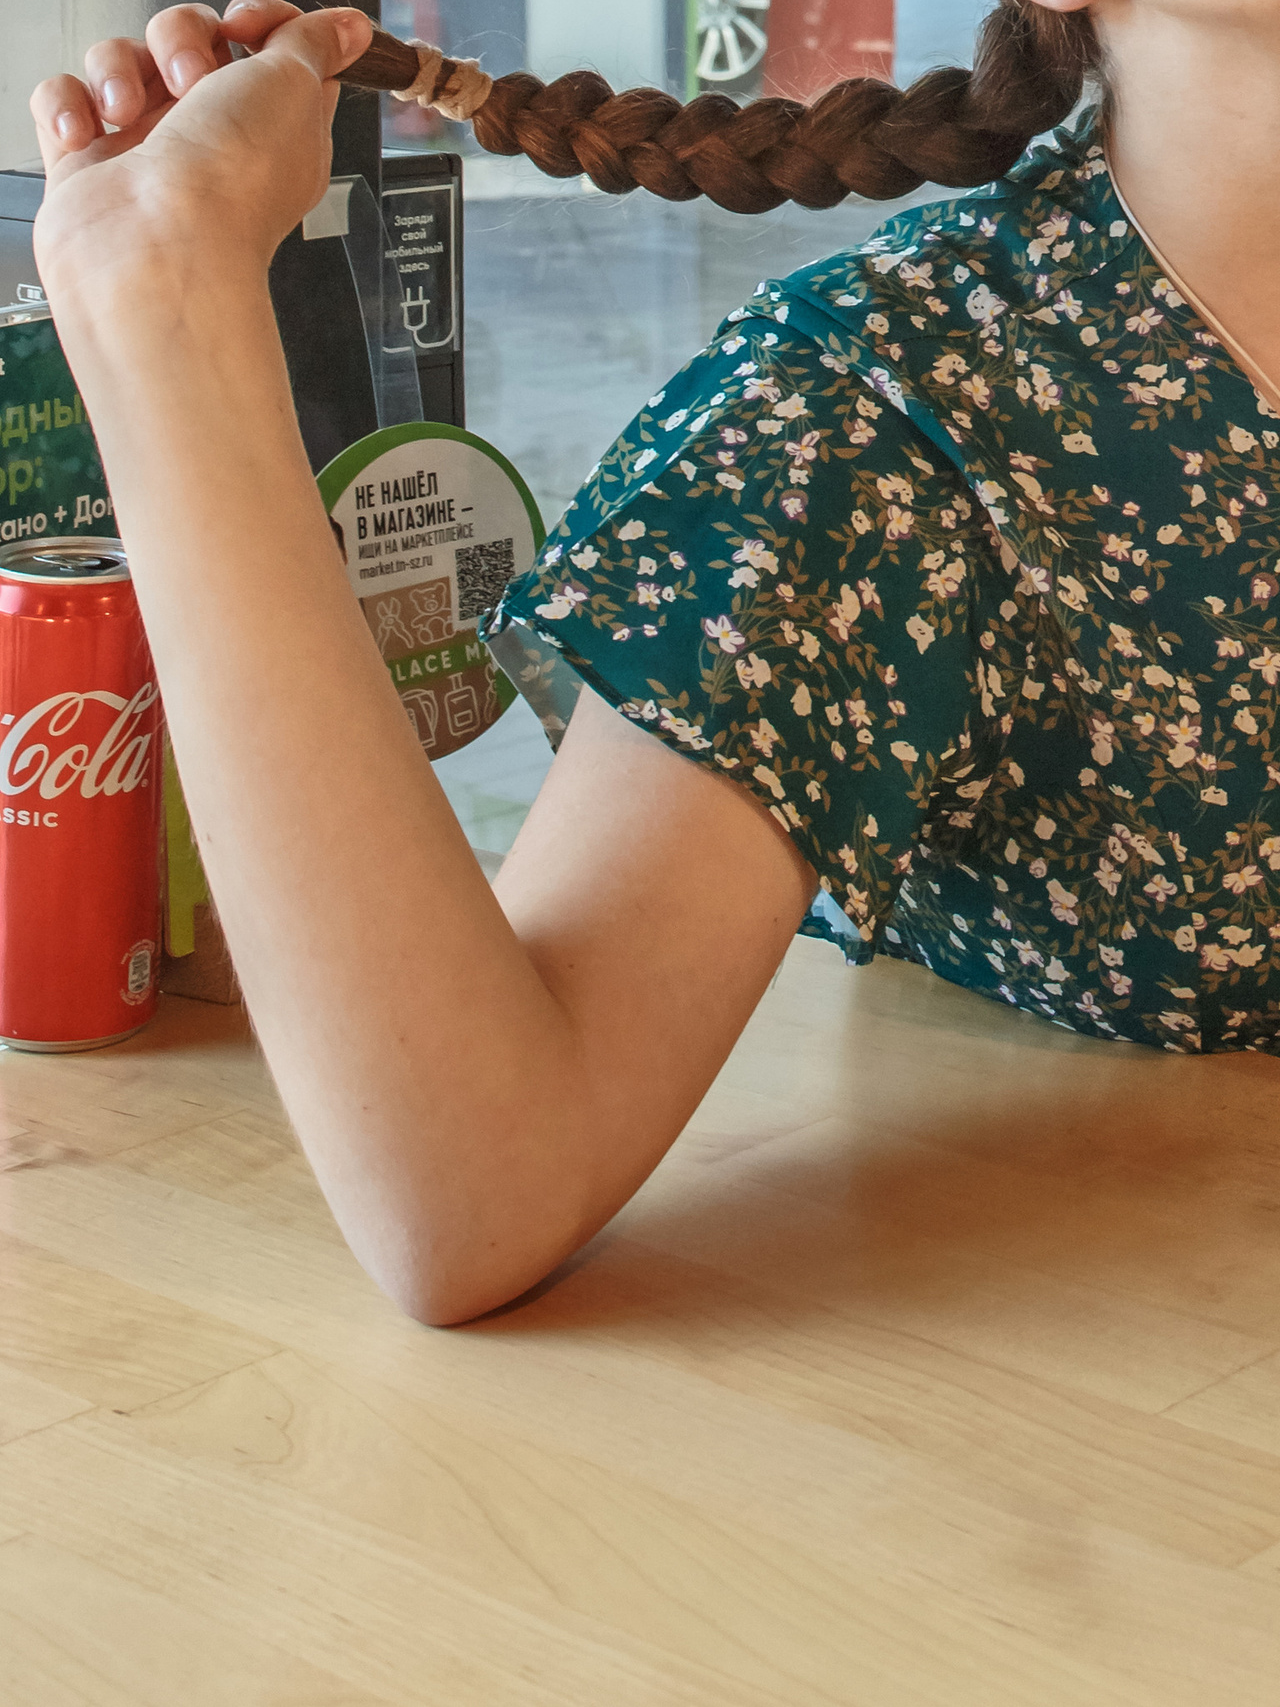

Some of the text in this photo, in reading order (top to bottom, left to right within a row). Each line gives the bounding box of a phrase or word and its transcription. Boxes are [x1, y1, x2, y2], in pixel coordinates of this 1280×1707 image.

[394, 214, 434, 228] Заряди
[401, 228, 427, 241] свой
[385, 241, 443, 258] мобильный
[399, 262, 430, 273] здесь
[355, 470, 438, 510] НЕ НАШЁЛ
[0, 512, 47, 543] ано
[357, 516, 367, 540] В
[373, 498, 456, 537] МАГАЗИНЕ
[358, 522, 474, 560] ИЩИ НА МАРКЕТПЛЕЙСЕ
[0, 807, 59, 828] SSIC
